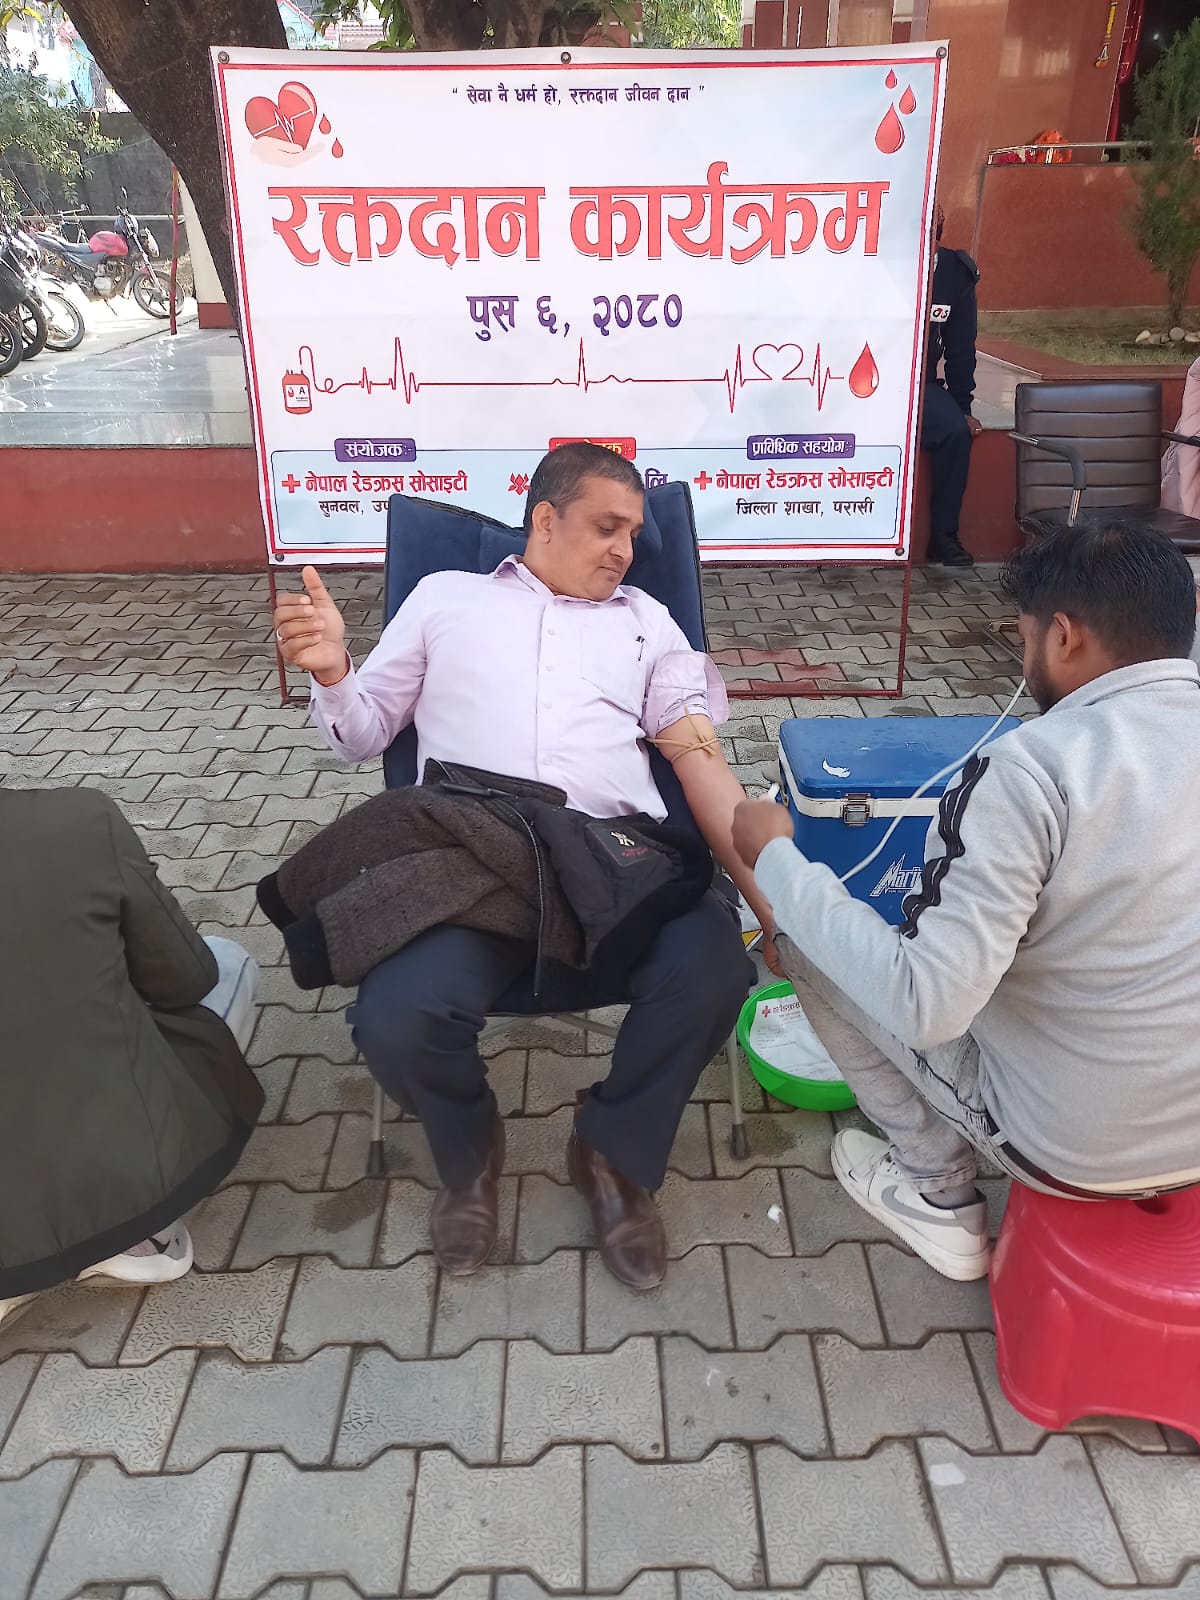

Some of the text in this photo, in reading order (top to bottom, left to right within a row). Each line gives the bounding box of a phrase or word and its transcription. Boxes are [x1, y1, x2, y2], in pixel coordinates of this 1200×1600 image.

[466, 85, 492, 105] सेवा
[498, 82, 509, 103] नै
[514, 84, 537, 103] धर्म
[543, 85, 561, 106] हो,
[569, 87, 619, 105] रक्तदान
[625, 83, 661, 103] जीवन
[667, 87, 690, 102] दान
[267, 161, 891, 269] रक्तदान कार्यक्रम
[466, 294, 683, 342] पुस ६, २०८०
[752, 437, 799, 456] प्राविधिक
[305, 469, 468, 494] नेपाल रेडक्रस सोसाइटी
[716, 467, 895, 490] नेपाल रेडक्रस सोसाइटी
[318, 500, 365, 518] सुनवल,
[736, 497, 875, 517] जिल्ला शाखा, परासी
